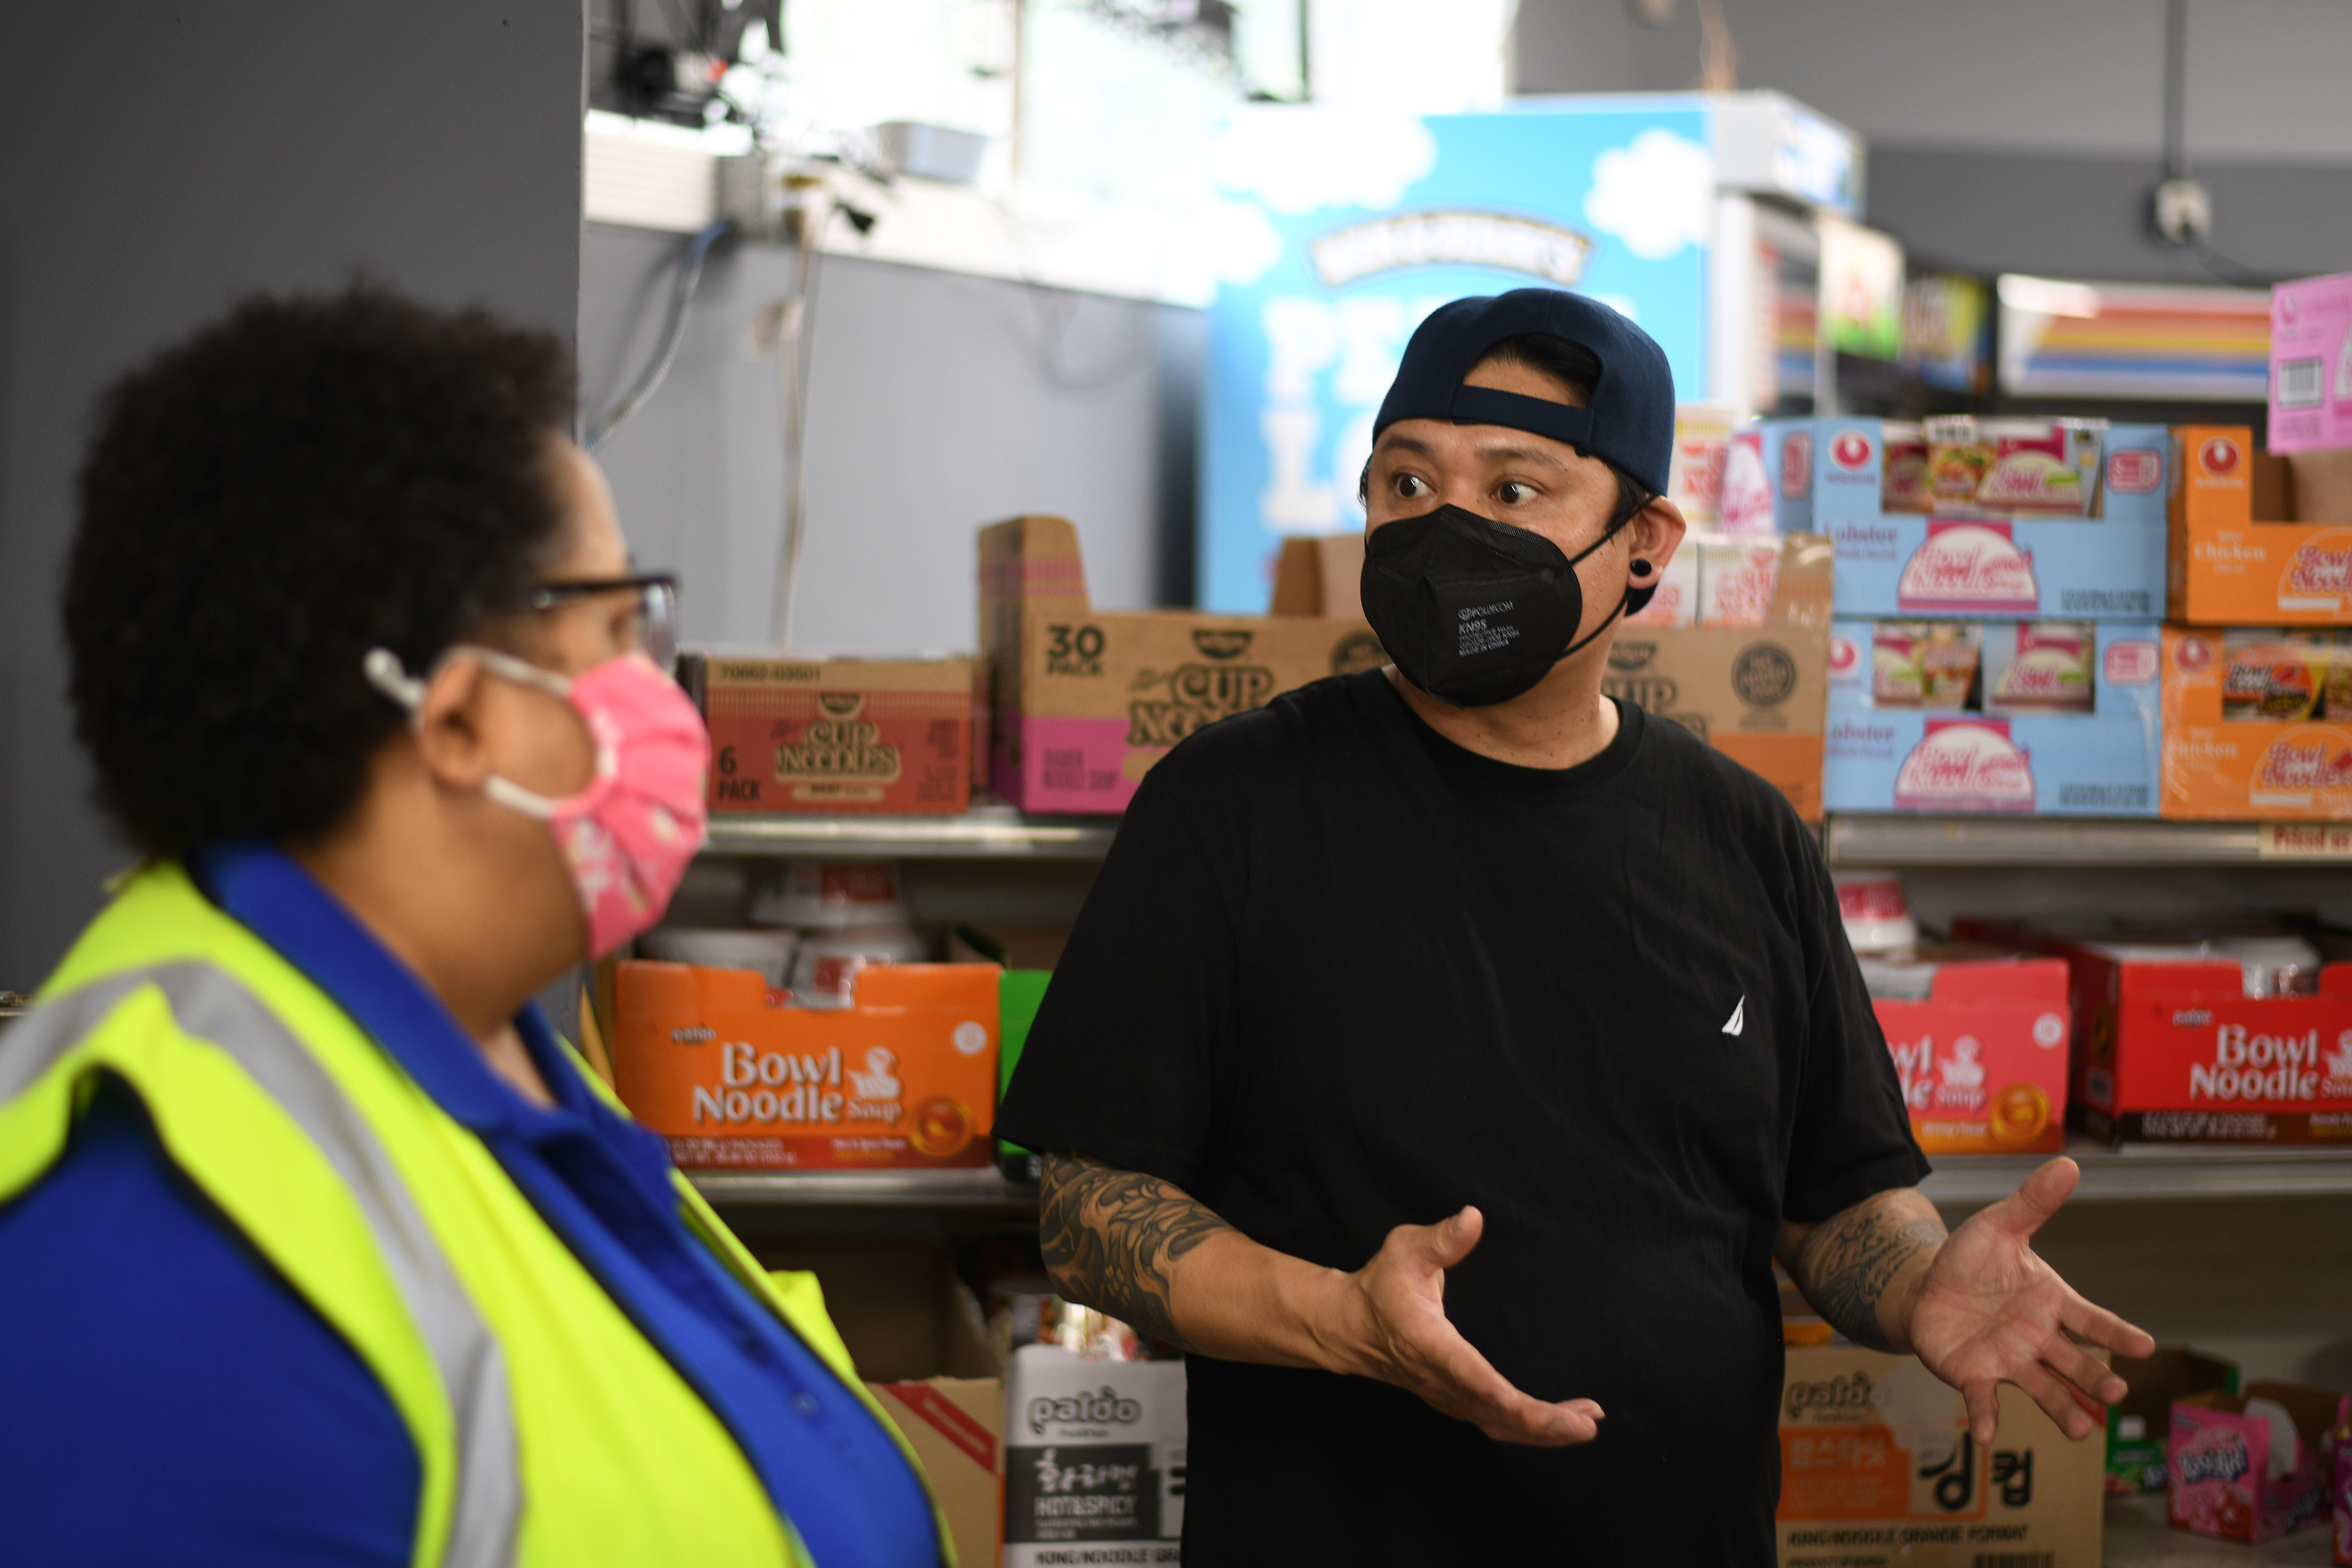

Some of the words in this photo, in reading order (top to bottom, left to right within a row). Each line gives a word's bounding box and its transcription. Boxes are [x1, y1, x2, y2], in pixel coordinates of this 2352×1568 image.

[1047, 626, 1105, 659] 30
[1047, 661, 1103, 677] PACK
[1170, 665, 1273, 709] CUP
[806, 720, 879, 748] CUP
[719, 747, 738, 775] 6
[778, 744, 898, 775] NOODLES
[719, 779, 760, 801] PACK
[2217, 1025, 2319, 1069] Bowl
[722, 1042, 842, 1088] Bowl
[1935, 1083, 1986, 1112] Soup
[2190, 1064, 2320, 1101] Noodle
[692, 1083, 844, 1123] Noodle
[847, 1099, 903, 1124] Soup
[1030, 1386, 1142, 1434] paldo
